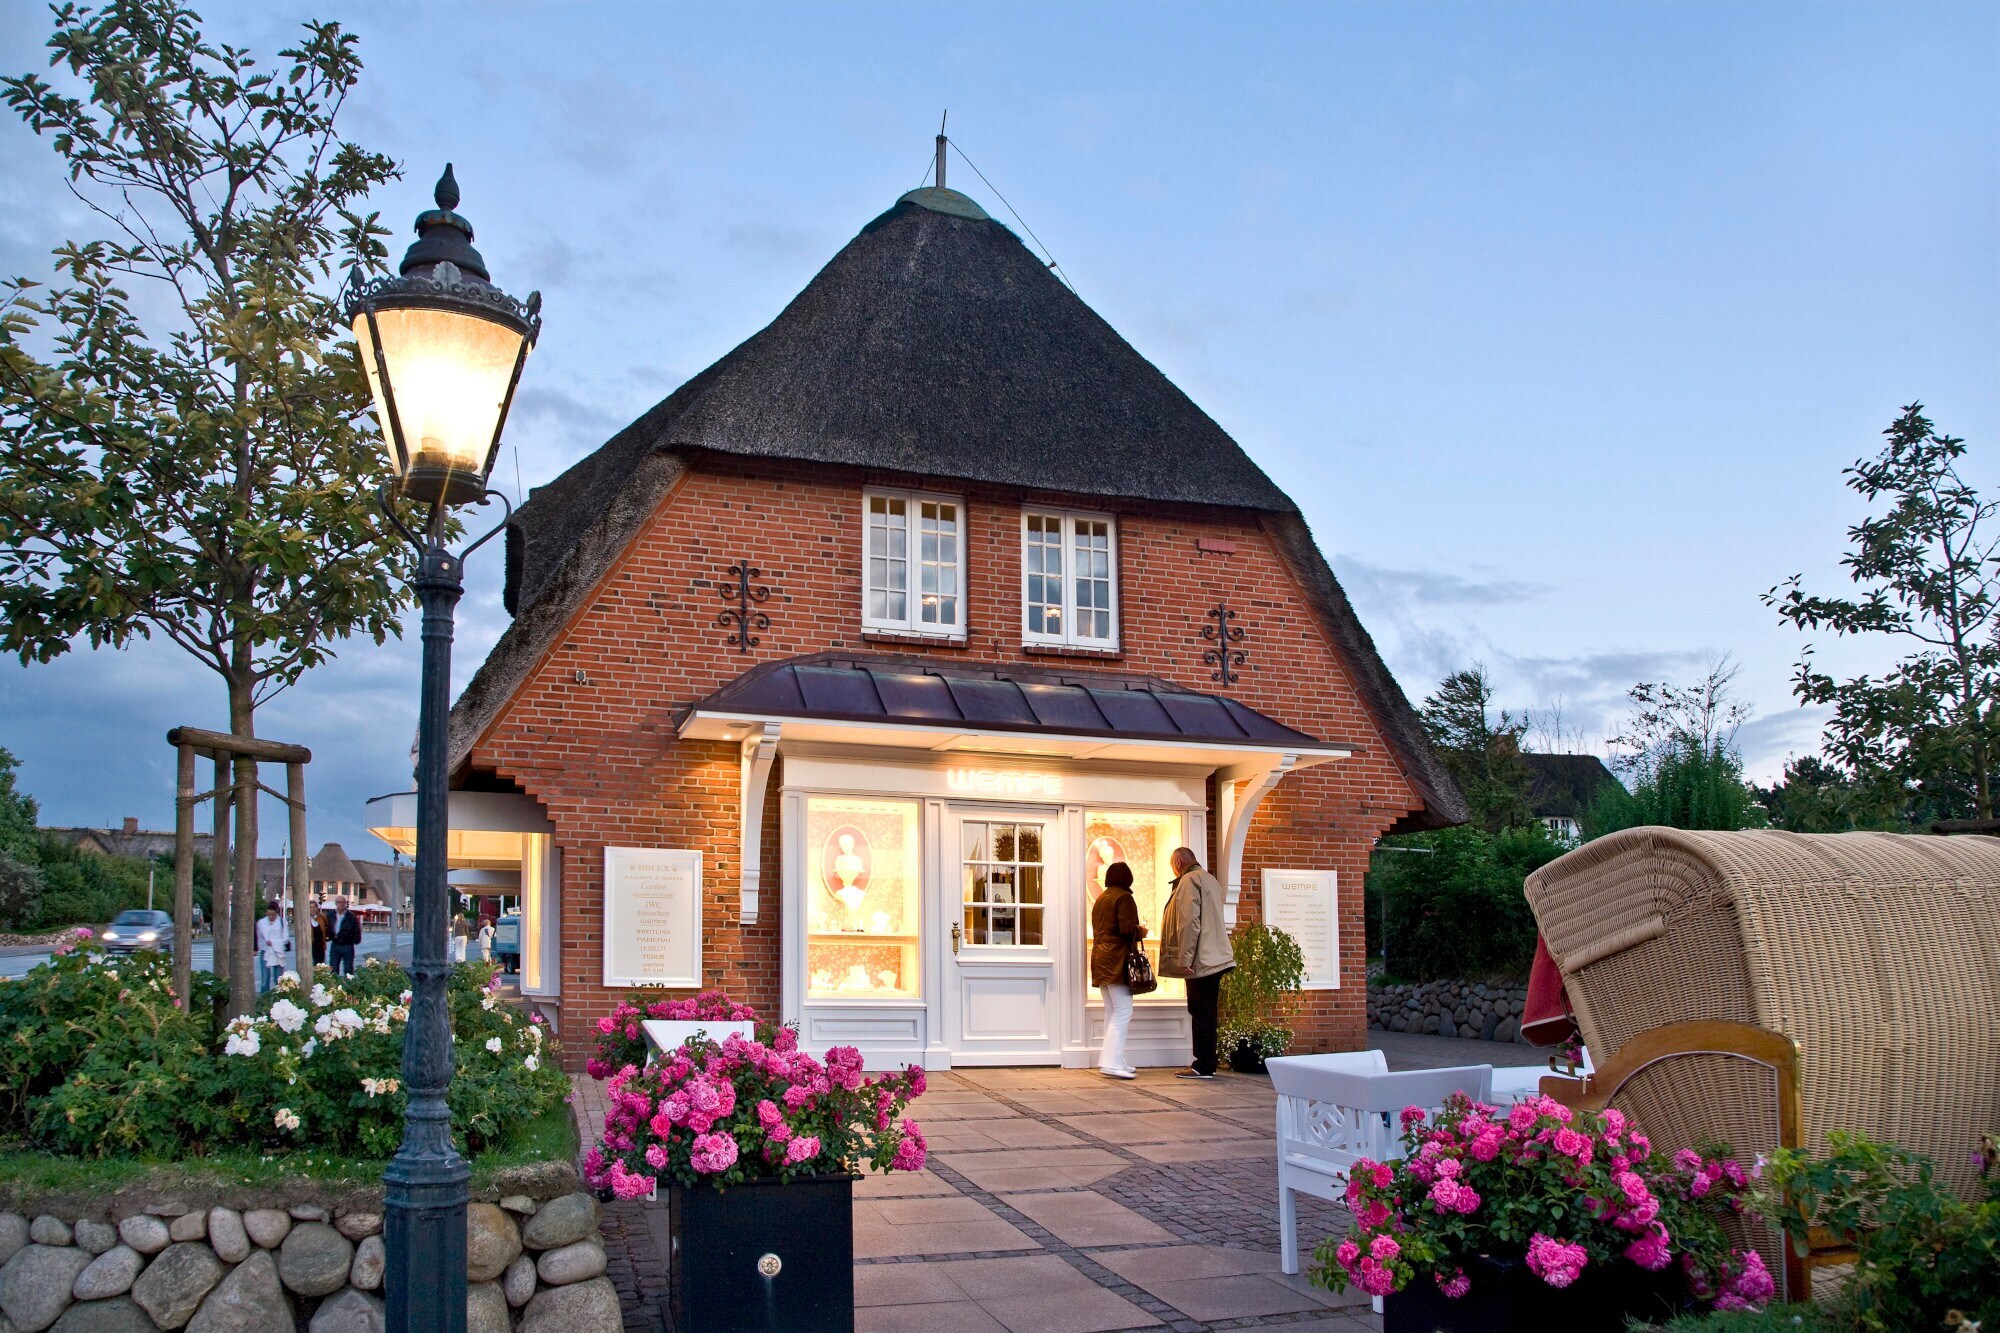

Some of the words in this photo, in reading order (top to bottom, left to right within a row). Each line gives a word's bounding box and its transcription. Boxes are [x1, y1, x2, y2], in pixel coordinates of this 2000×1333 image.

[947, 768, 1062, 795] WEMPE
[638, 864, 669, 872] ROLEX
[640, 881, 668, 890] Cartier
